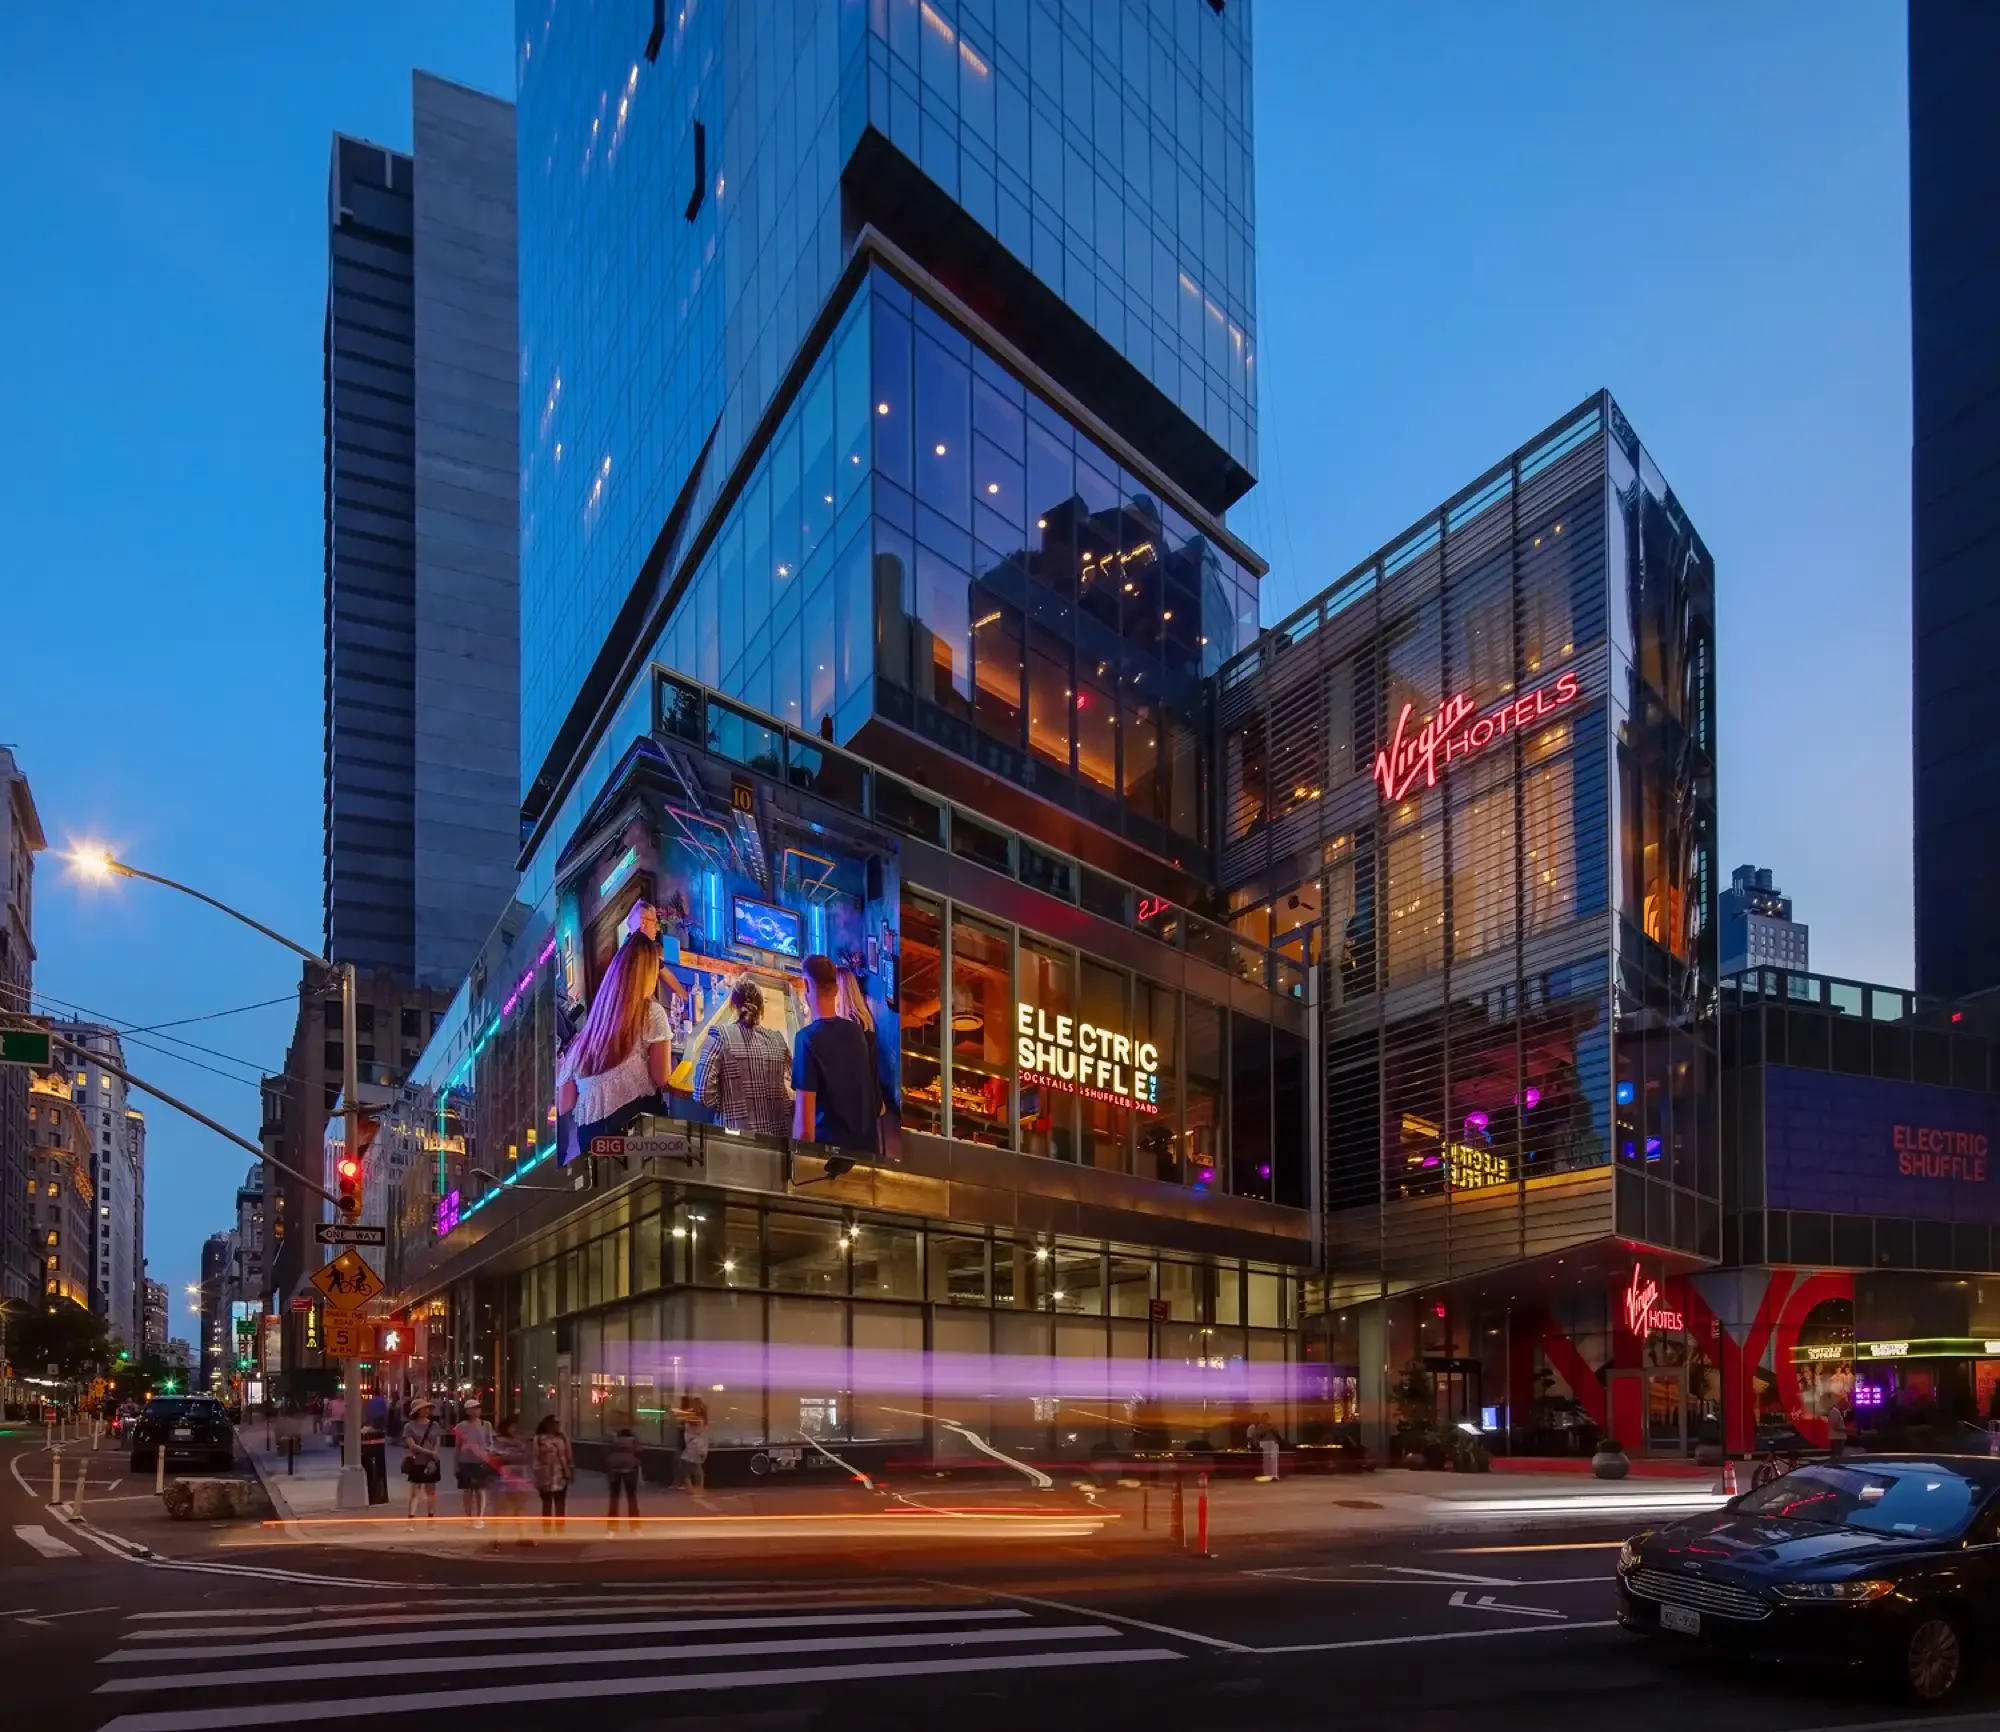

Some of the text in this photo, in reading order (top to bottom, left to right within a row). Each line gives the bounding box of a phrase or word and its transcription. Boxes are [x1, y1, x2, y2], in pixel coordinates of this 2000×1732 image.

[1374, 671, 1579, 801] Virgin HOTELS
[733, 786, 752, 810] 10
[1018, 1003, 1159, 1073] ELECTRIC
[1018, 1037, 1149, 1102] SHUFFLE
[1149, 1075, 1157, 1103] NYC
[596, 1139, 684, 1153] BIG OUTDOOR
[1893, 1125, 1987, 1156] ELECTRIC
[1899, 1152, 1986, 1181] SHUFFLE
[326, 1229, 378, 1241] ONE WAY
[1625, 1262, 1659, 1339] Virgin
[1648, 1309, 1684, 1331] HOTELS
[336, 1330, 349, 1345] 5
